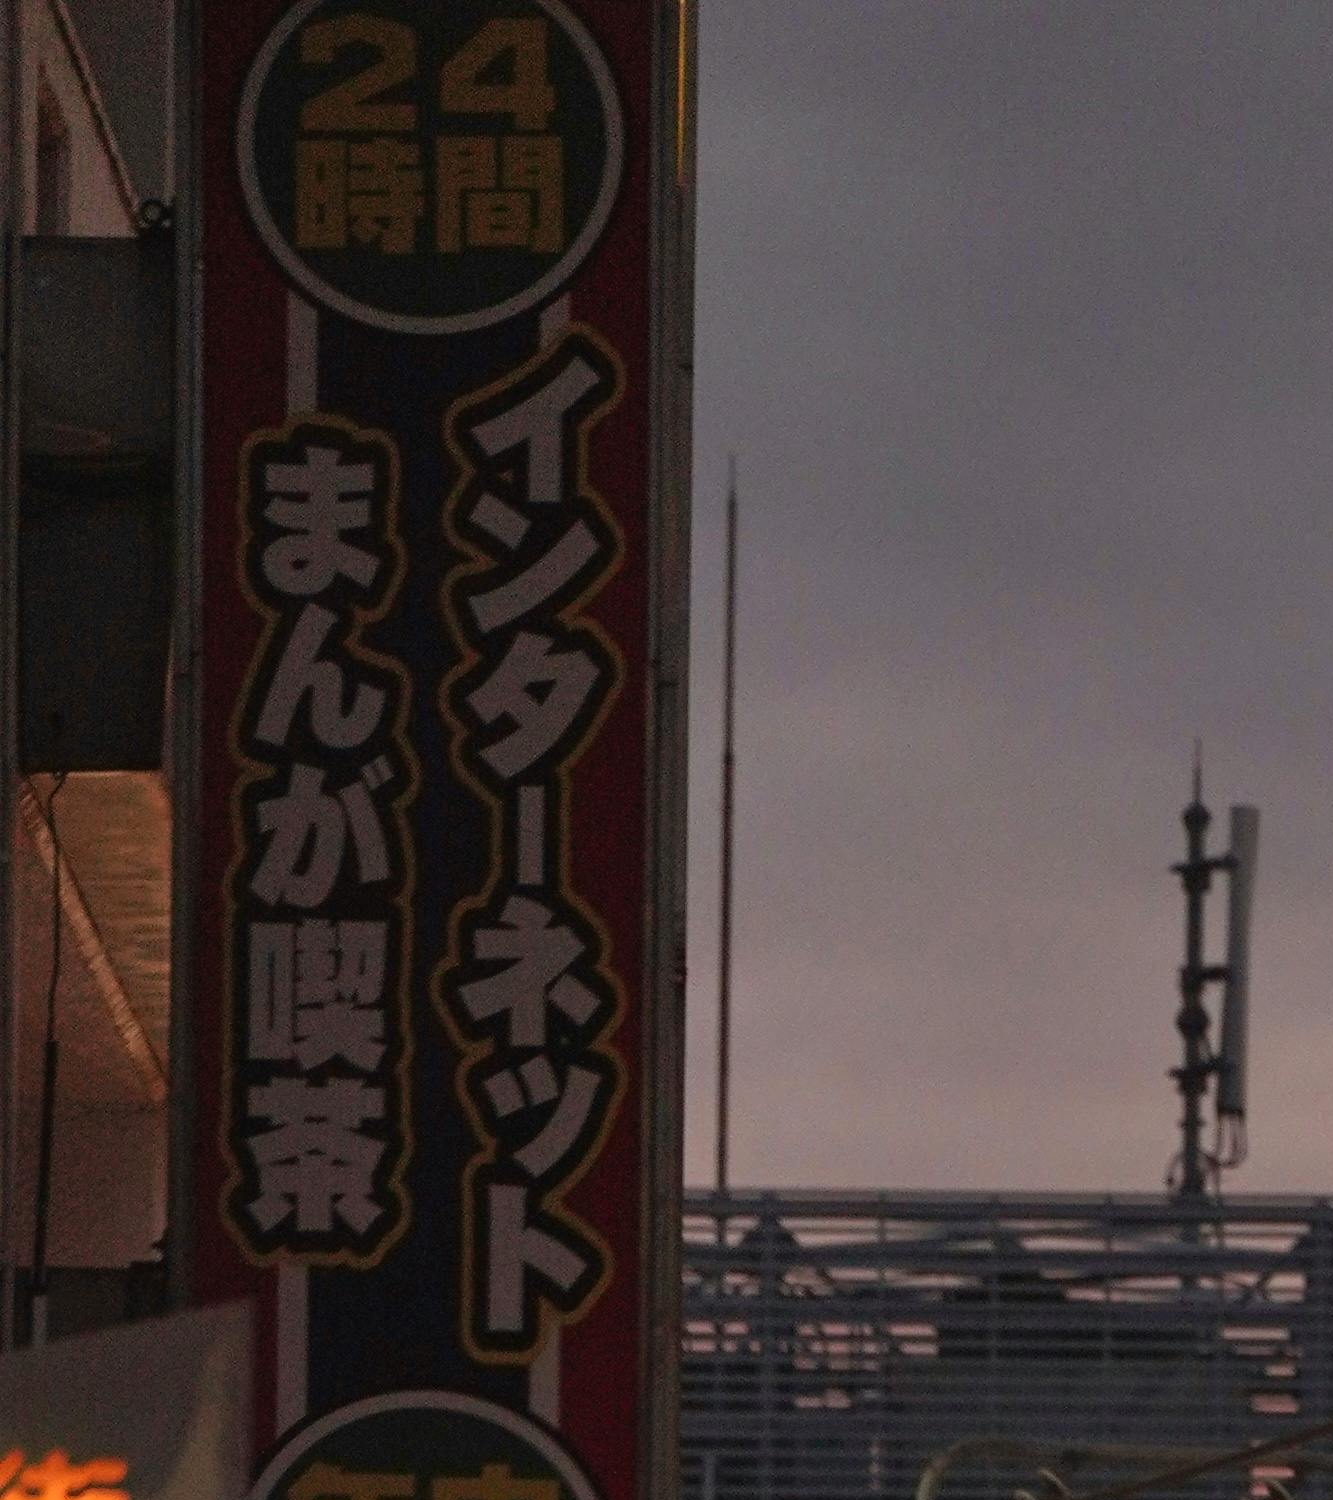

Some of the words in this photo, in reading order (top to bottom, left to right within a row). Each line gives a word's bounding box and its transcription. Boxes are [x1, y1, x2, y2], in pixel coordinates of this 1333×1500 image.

[295, 136, 564, 254] 時間
[300, 16, 556, 132] 24
[248, 445, 392, 1234] まんが喫茶
[460, 358, 604, 1332] インターネット
